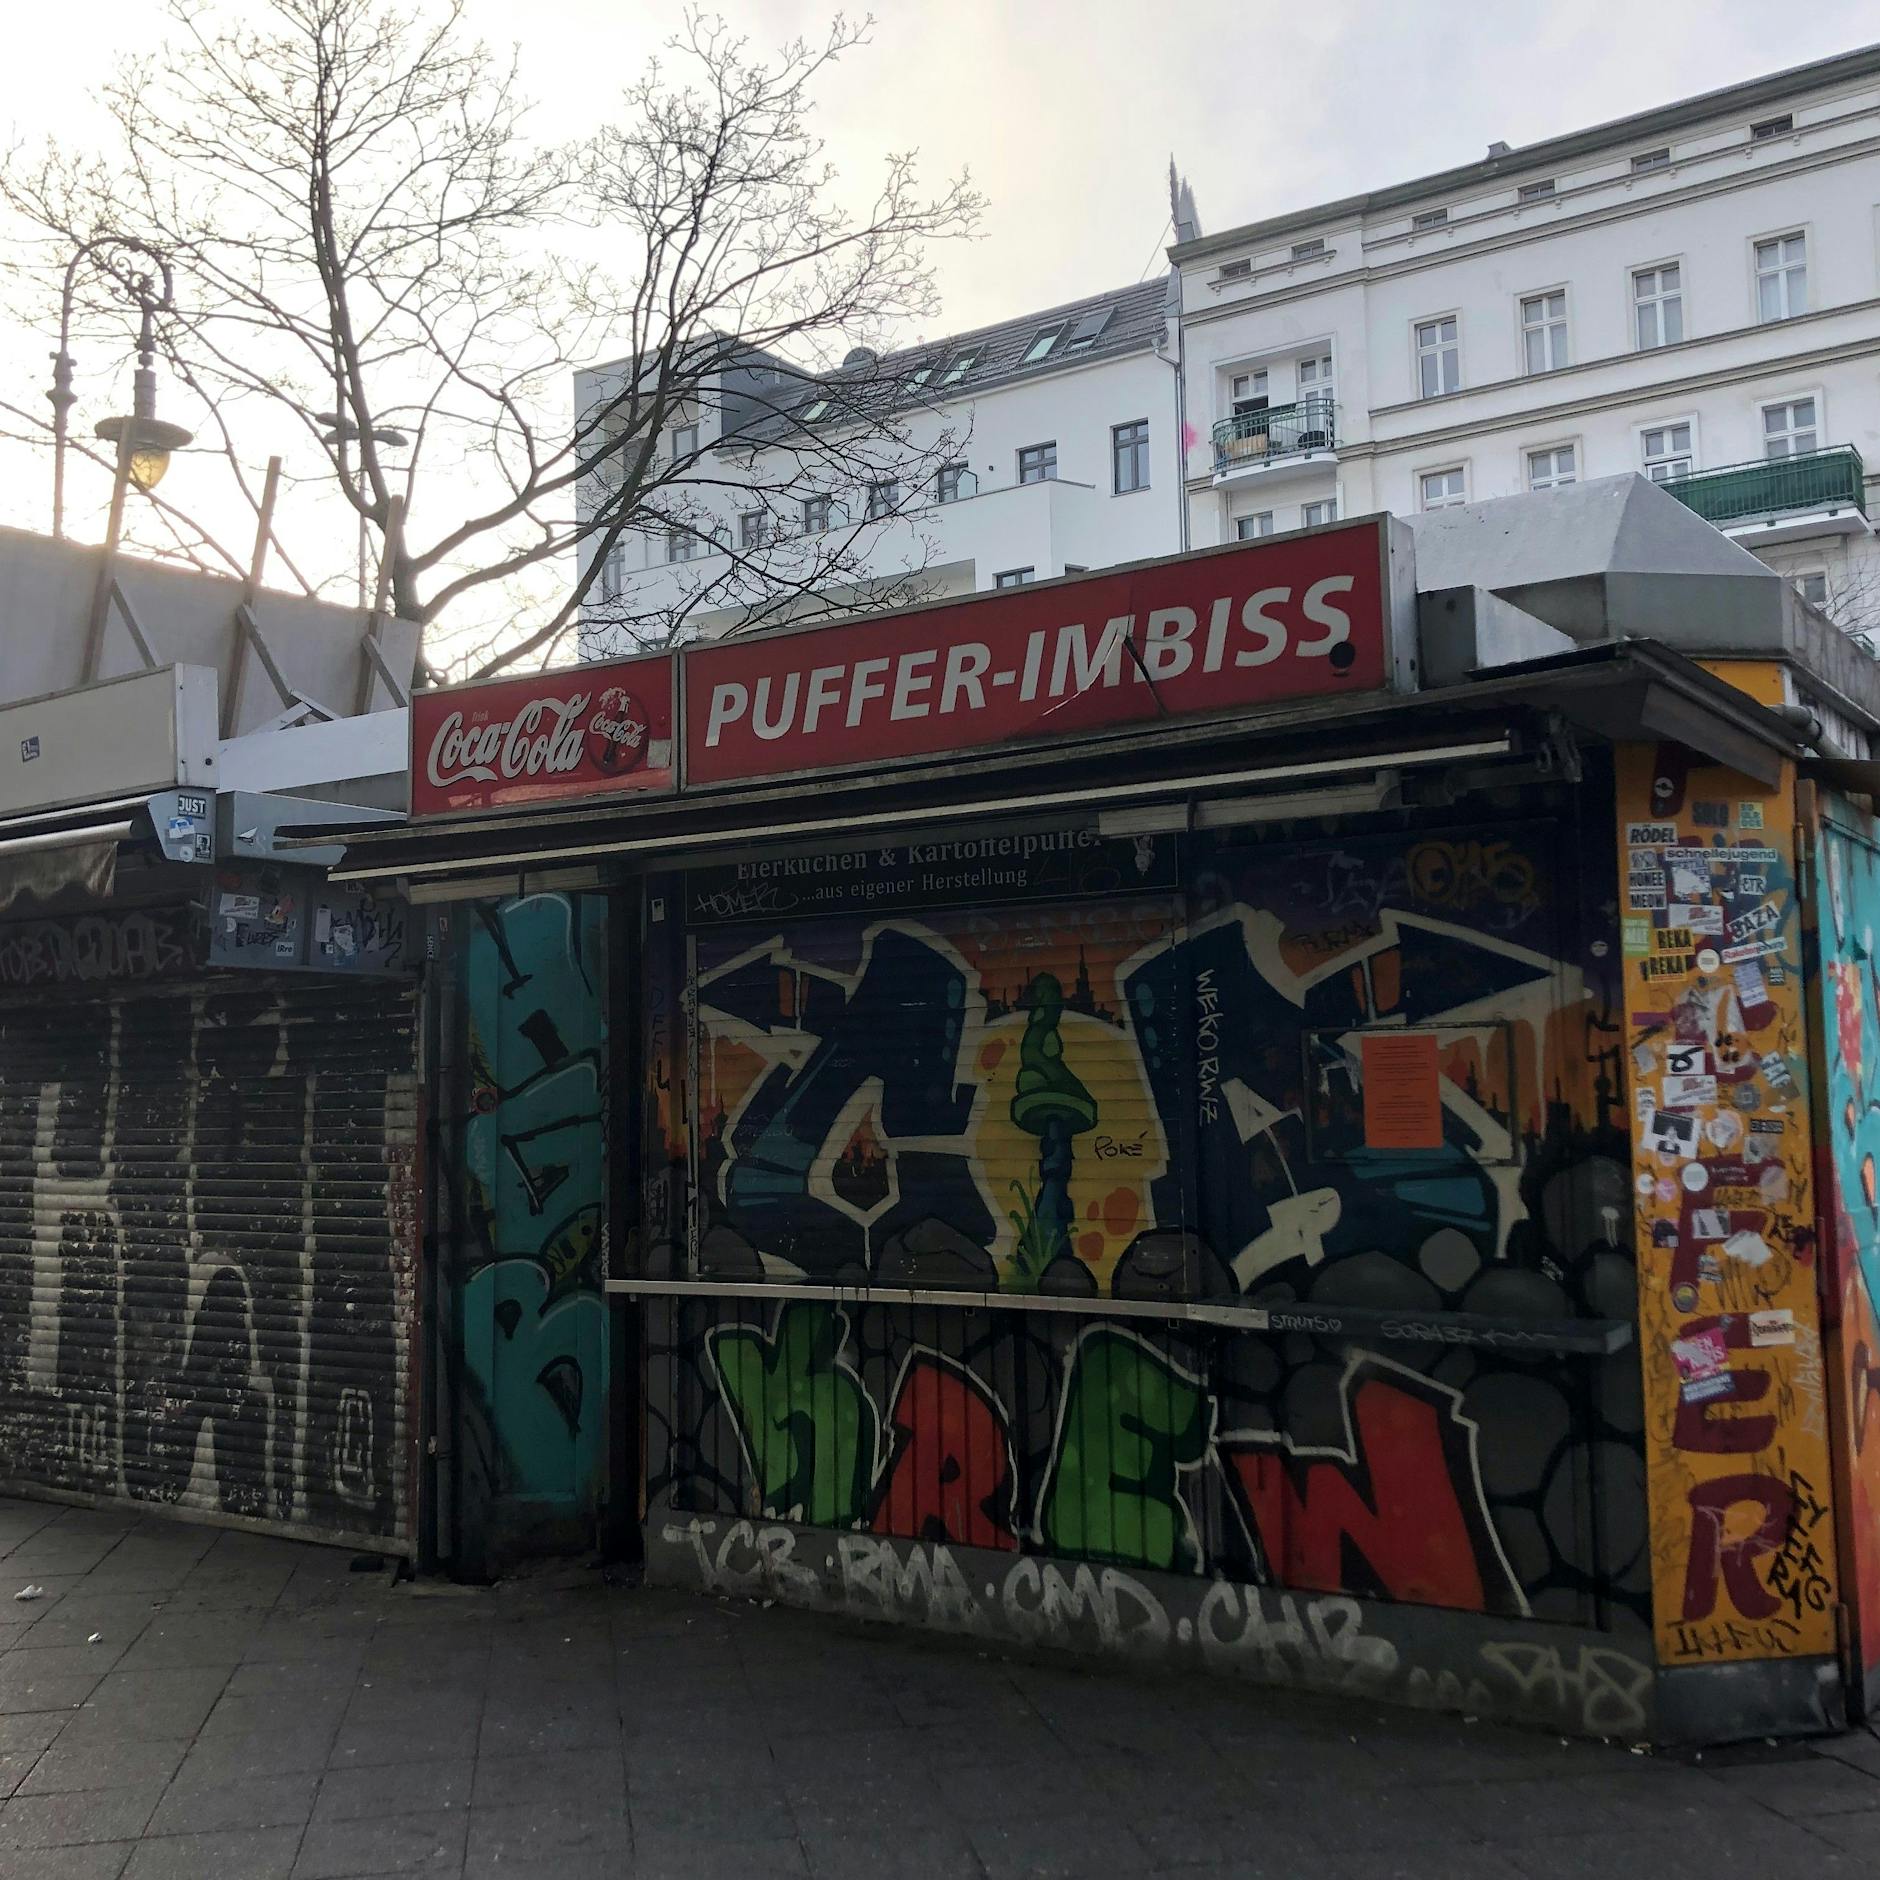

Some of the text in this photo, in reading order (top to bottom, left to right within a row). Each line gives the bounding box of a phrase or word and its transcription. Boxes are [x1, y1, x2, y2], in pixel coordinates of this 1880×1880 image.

[705, 574, 1355, 748] PUFFER-IMBISS
[427, 690, 592, 788] Coca-Cola
[178, 796, 206, 814] JUST
[1630, 824, 1675, 843] RÖDEL
[878, 848, 896, 867] &
[1666, 849, 1777, 861] schnellejugend
[850, 878, 914, 899] eigener
[921, 868, 1028, 891] Herstellung
